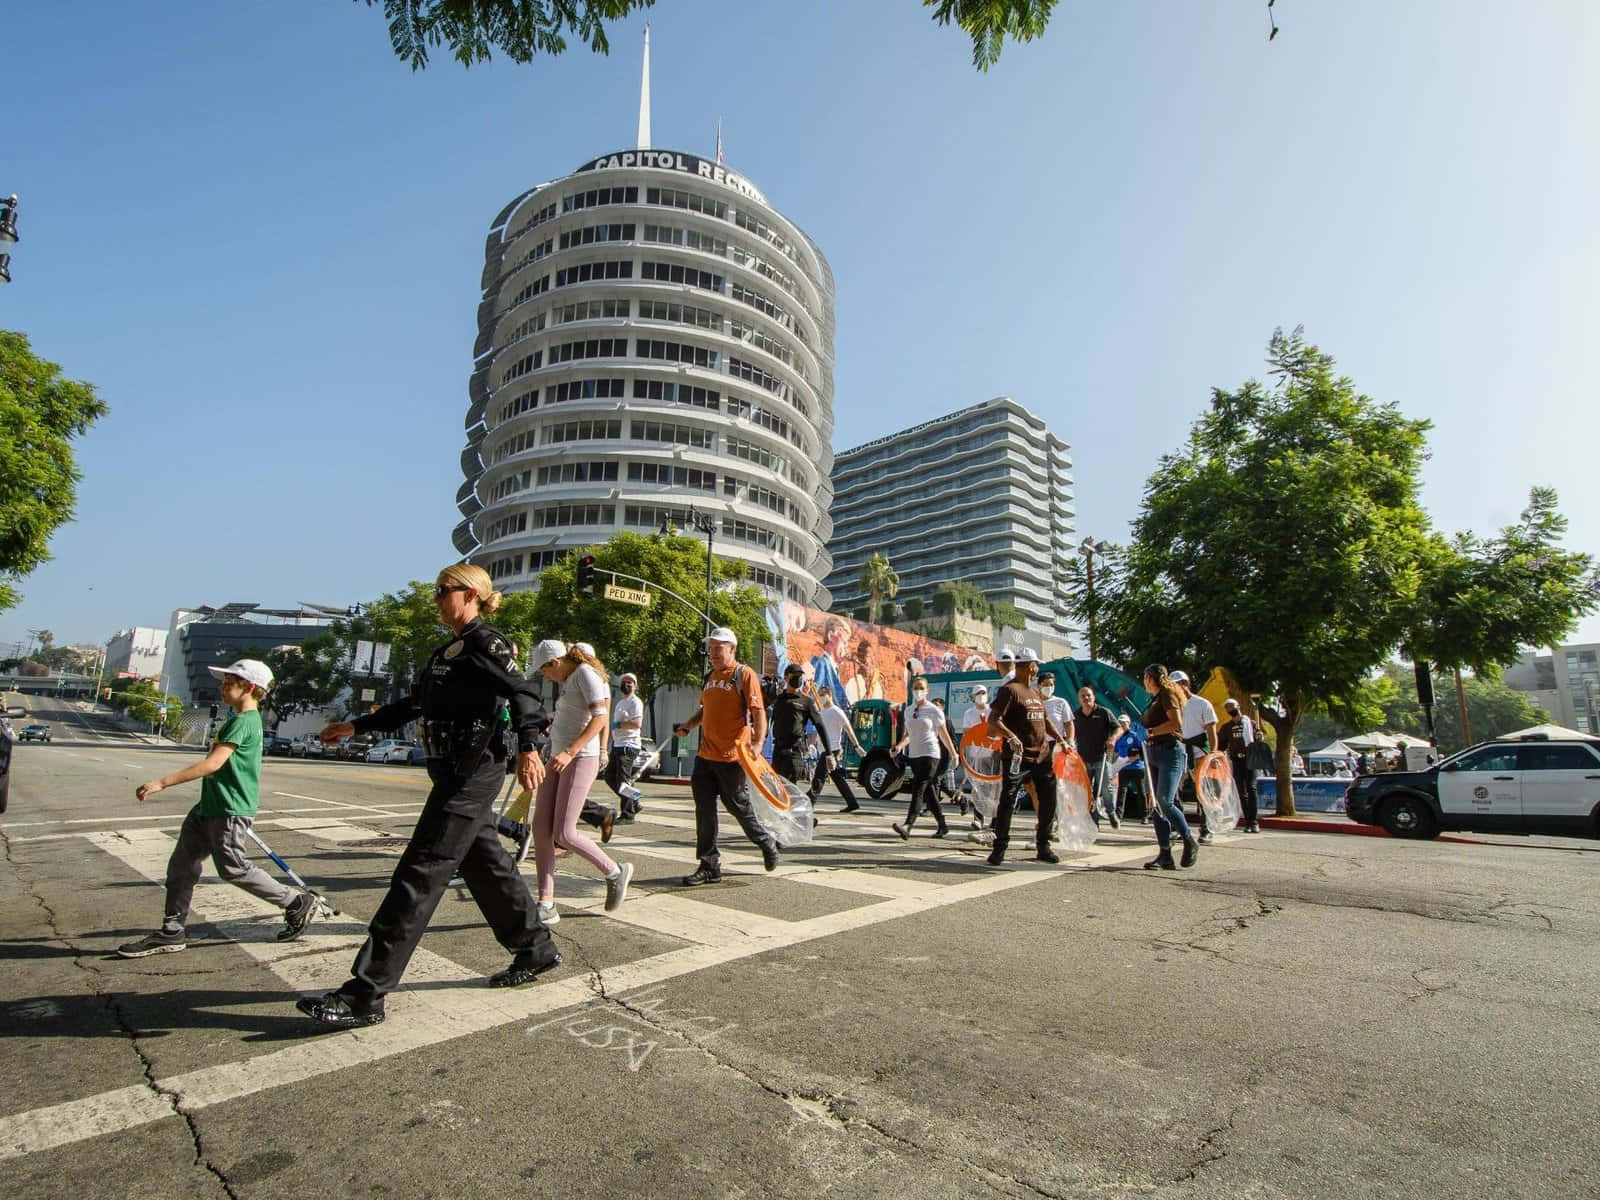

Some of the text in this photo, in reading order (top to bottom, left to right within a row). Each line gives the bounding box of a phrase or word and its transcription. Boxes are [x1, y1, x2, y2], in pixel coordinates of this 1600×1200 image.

[595, 151, 689, 171] CAPITOL
[609, 588, 647, 604] PED XING
